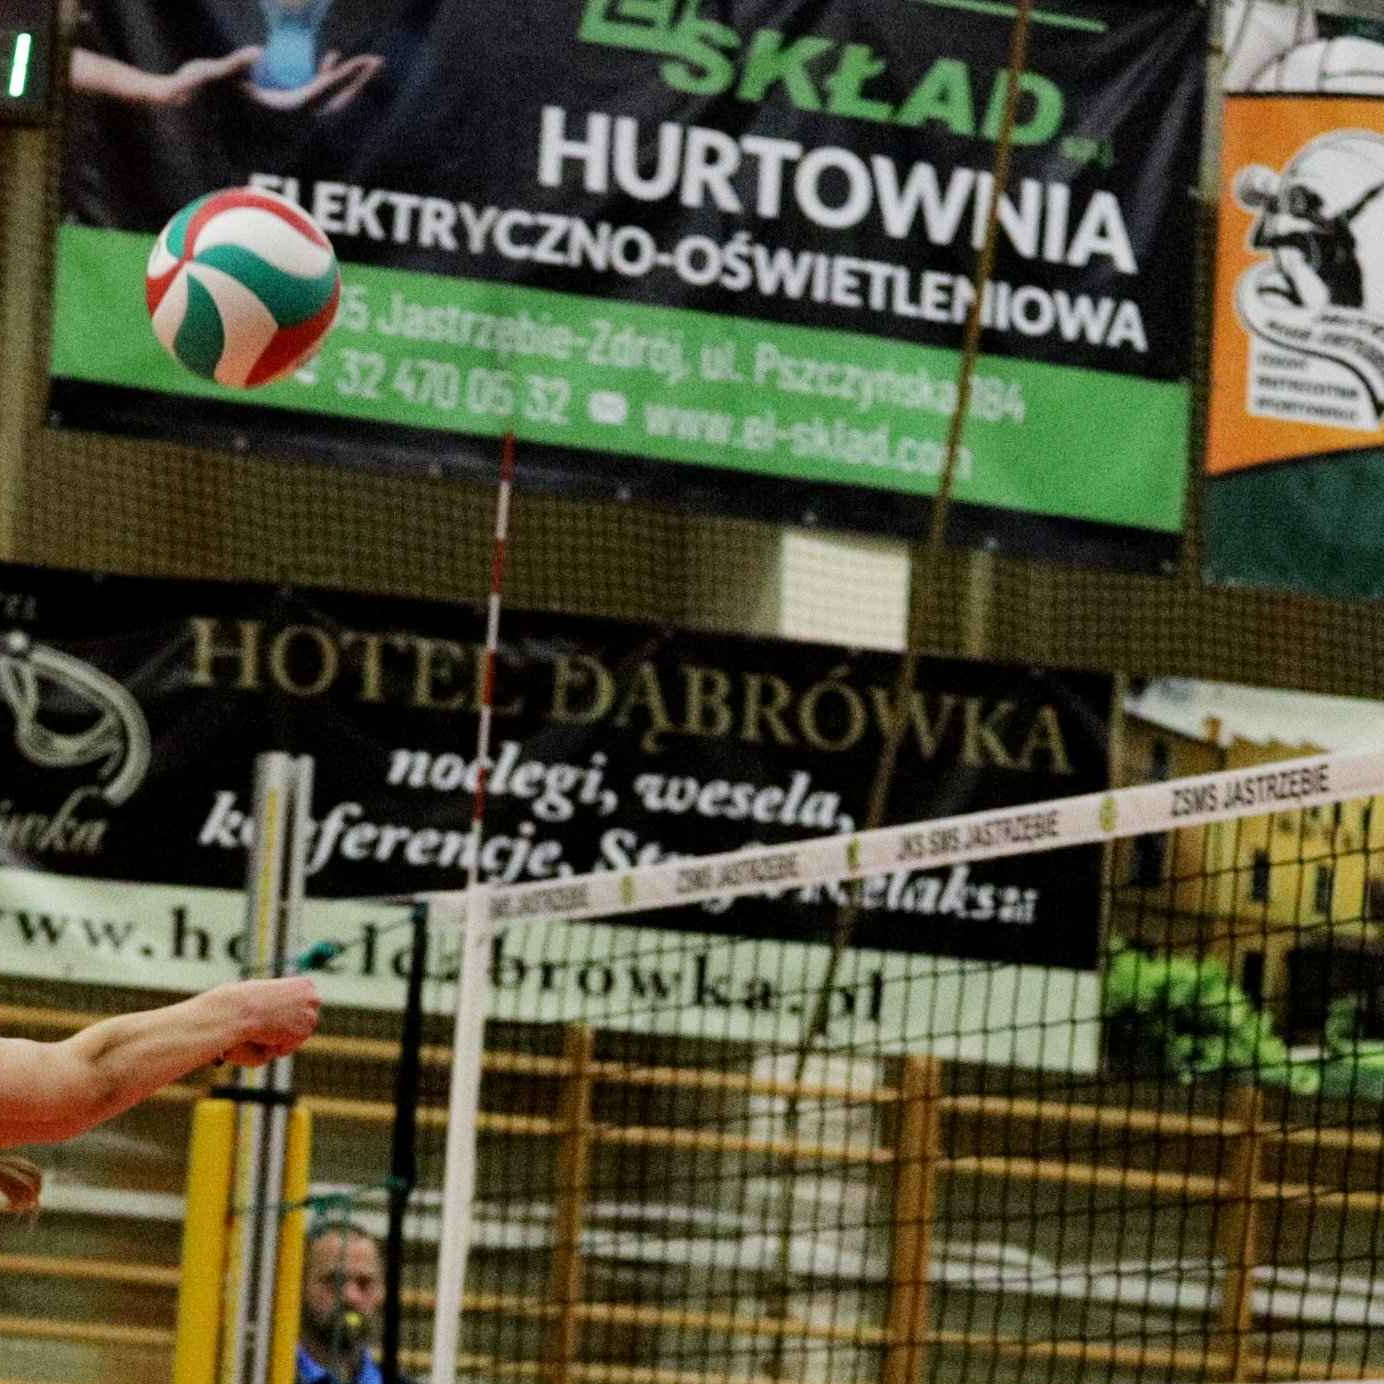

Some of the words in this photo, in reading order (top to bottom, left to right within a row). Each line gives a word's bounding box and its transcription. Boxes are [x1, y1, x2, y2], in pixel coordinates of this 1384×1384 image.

[537, 105, 1138, 275] HURTOWNIA
[337, 349, 385, 399] 32
[393, 358, 459, 410] 470
[521, 374, 571, 426] 32
[189, 615, 524, 715] HOTEL
[552, 653, 1073, 776] DĄBRÓWKA
[387, 740, 617, 822] noclegi,
[635, 768, 856, 834] wesela,
[200, 790, 574, 883] kferencje,
